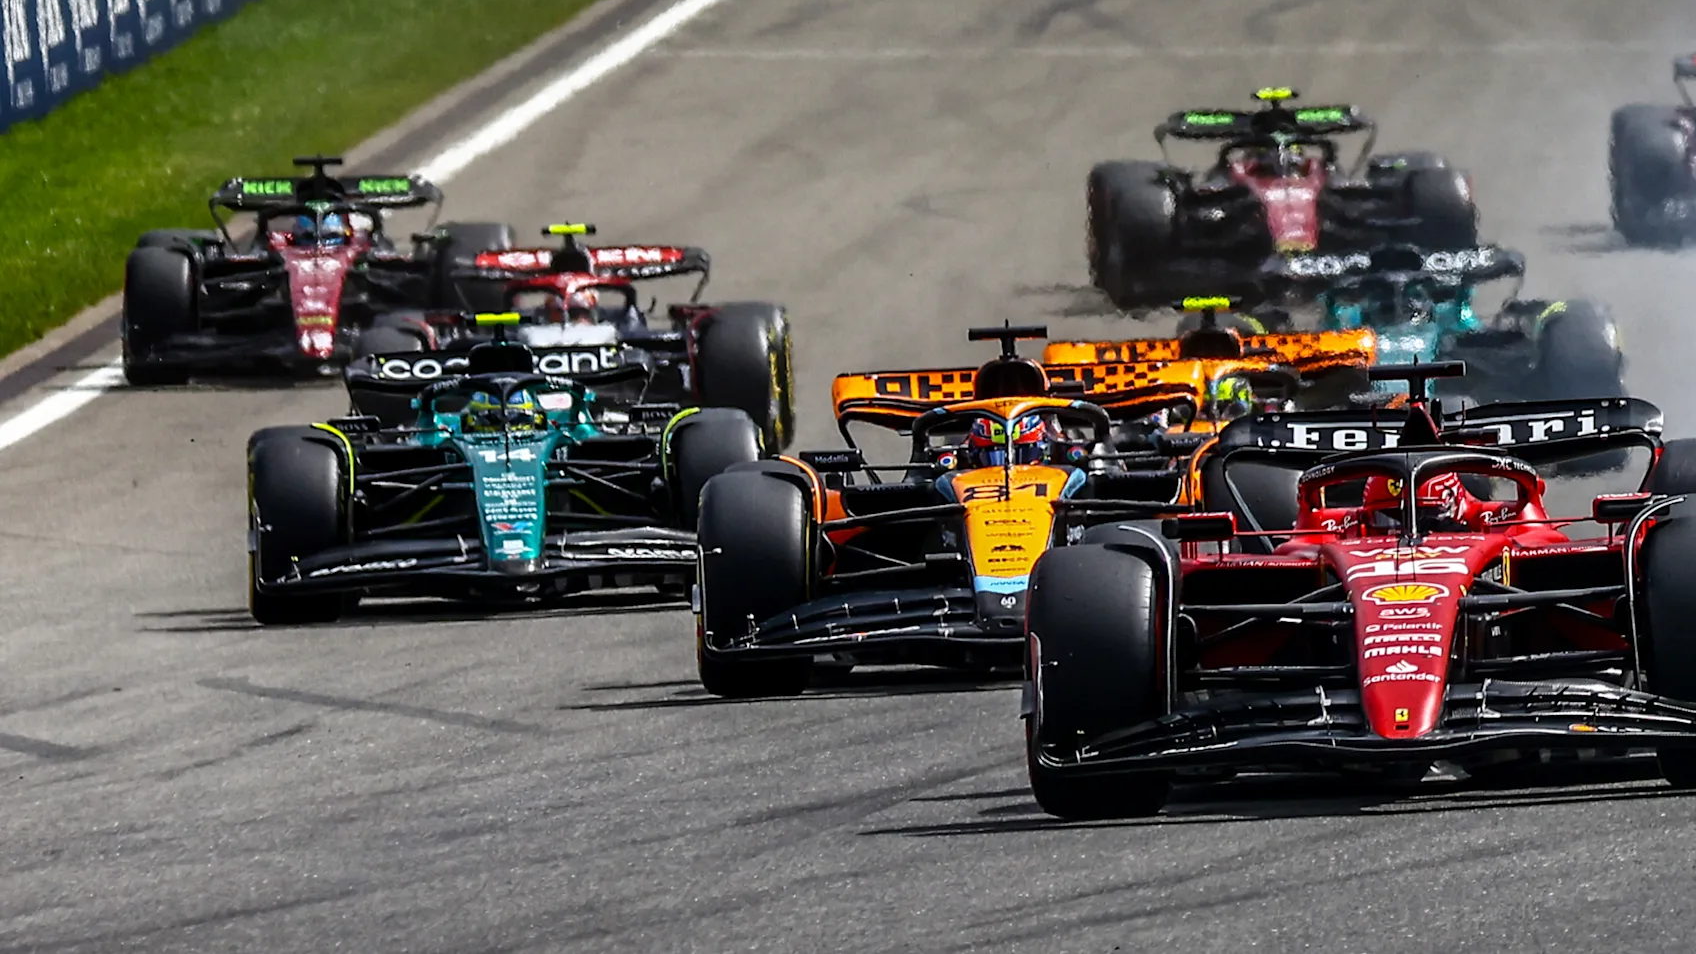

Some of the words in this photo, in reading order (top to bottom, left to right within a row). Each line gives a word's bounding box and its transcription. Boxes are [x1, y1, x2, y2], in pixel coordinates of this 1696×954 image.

[381, 348, 618, 380] coant
[478, 448, 537, 463] 14
[814, 454, 849, 464] Medallia
[1346, 558, 1469, 582] 16
[1380, 607, 1429, 617] aws
[1383, 622, 1443, 630] Palantir
[1364, 646, 1443, 659] MAHLE
[1362, 673, 1441, 687] Santander
